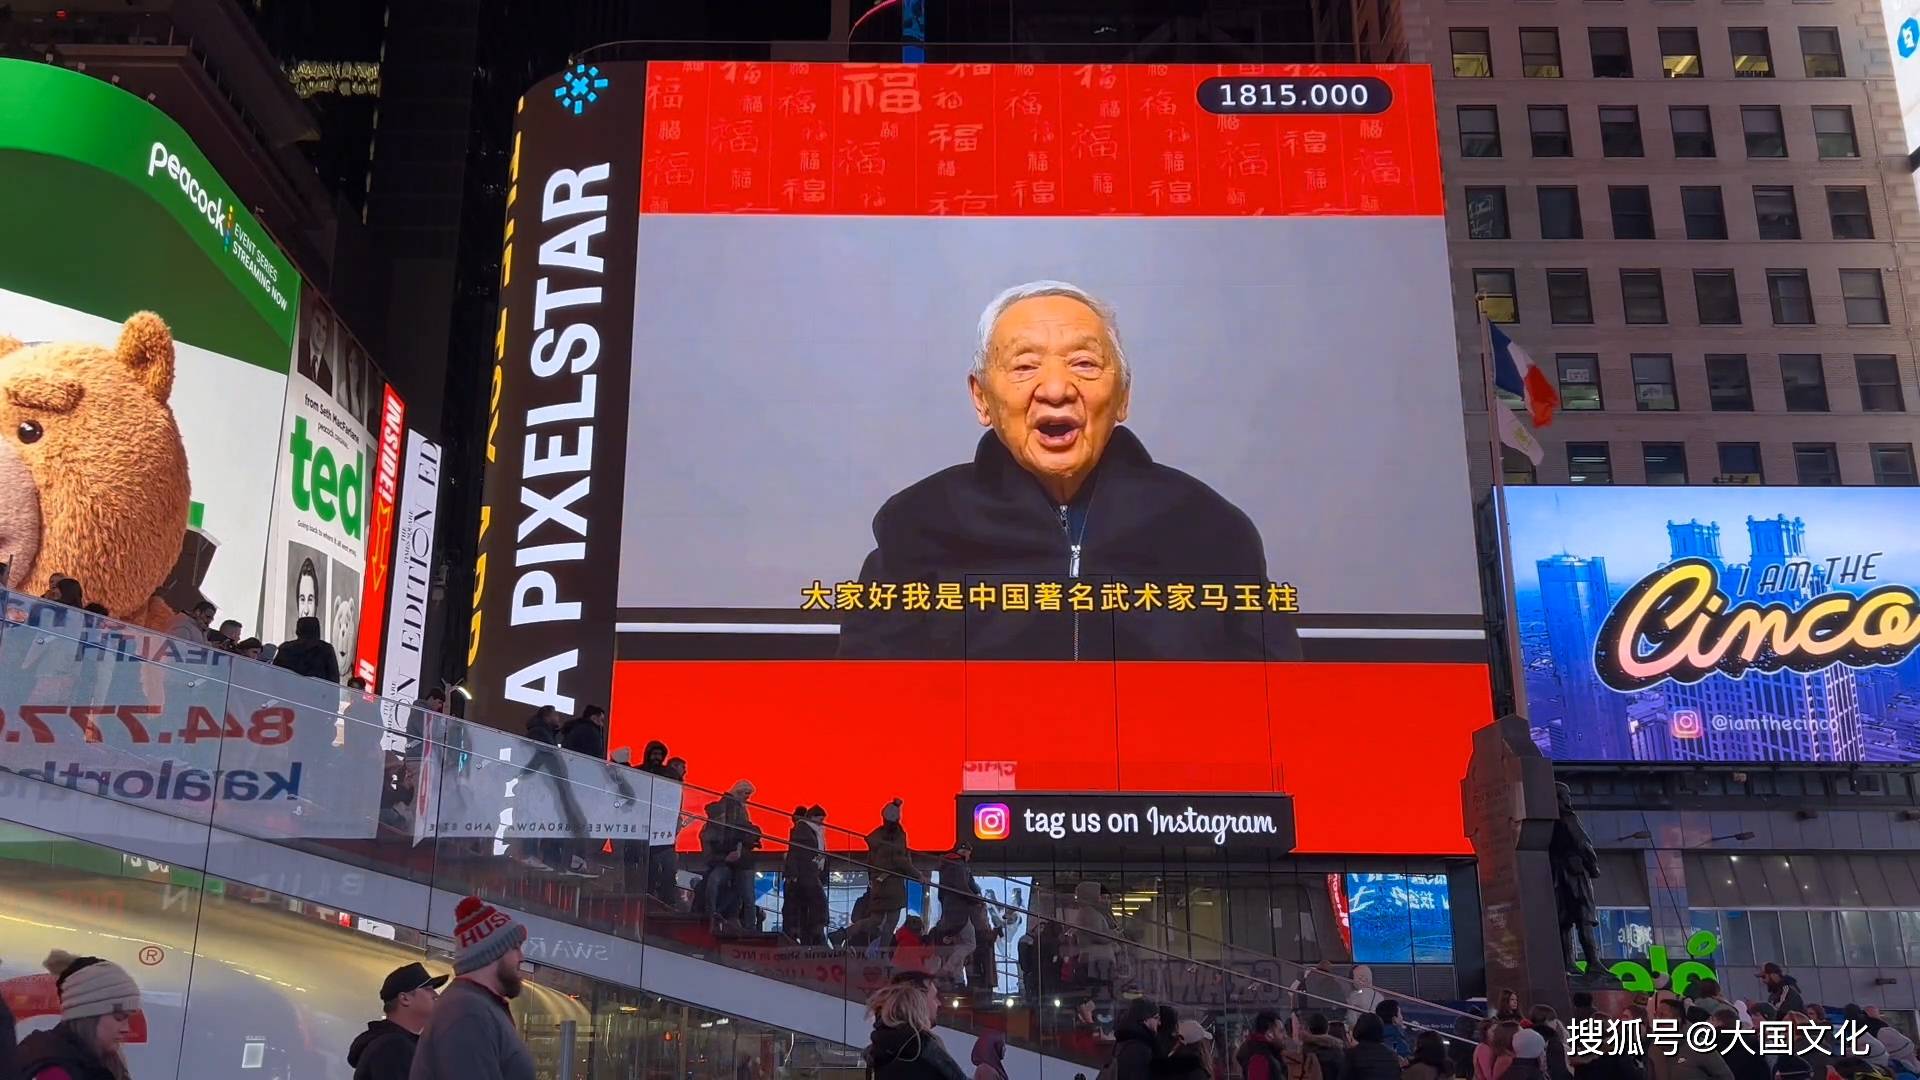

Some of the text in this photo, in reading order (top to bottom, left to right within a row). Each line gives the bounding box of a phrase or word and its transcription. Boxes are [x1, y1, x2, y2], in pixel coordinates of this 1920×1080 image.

[1219, 84, 1368, 106] 1815.000
[927, 123, 984, 152] 福
[148, 141, 225, 237] peacock
[233, 240, 288, 311] STREAMING NOW
[234, 222, 278, 282] EVENT SERIES
[304, 393, 360, 444] from Seth MacFarlane
[504, 162, 610, 715] A PIXELSTAR
[290, 415, 364, 541] ted
[374, 394, 403, 505] INSIDE!
[402, 508, 434, 652] EDITION
[801, 581, 1298, 612] 大家好我是中国著名武术家马玉柱
[1737, 552, 1883, 595] I AM THE
[1618, 564, 1920, 679] Cinco
[1711, 716, 1840, 733] @iamthecinco
[1024, 806, 1277, 844] tag us on Instagram
